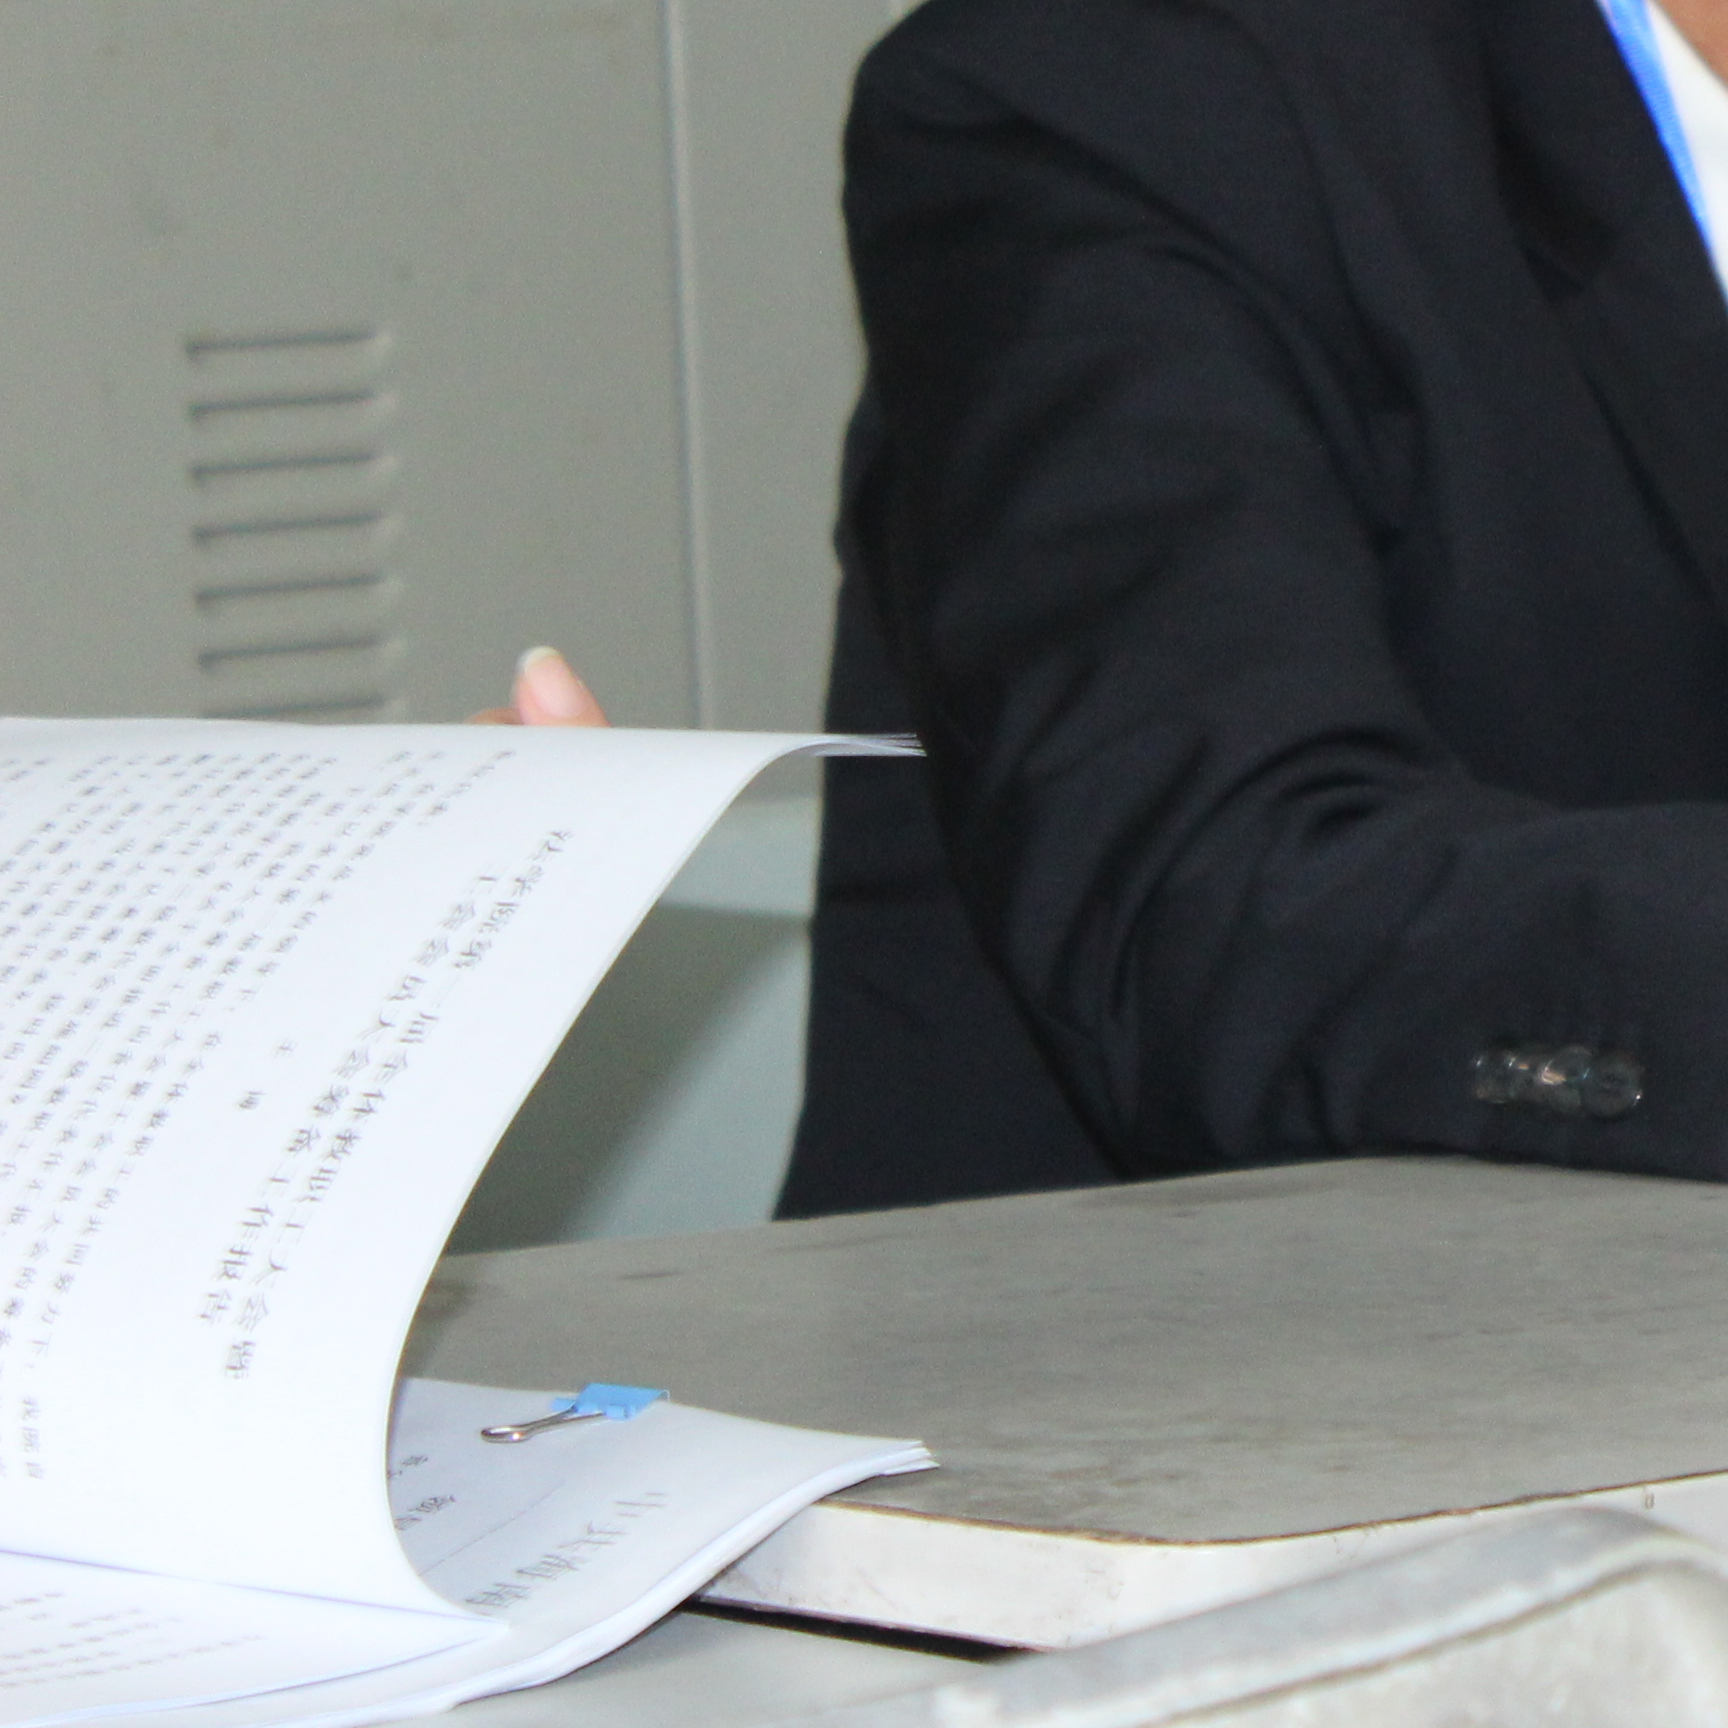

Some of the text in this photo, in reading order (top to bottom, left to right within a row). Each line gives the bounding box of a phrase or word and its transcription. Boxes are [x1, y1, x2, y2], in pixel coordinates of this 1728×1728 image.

[195, 859, 509, 1329] 工会会员大会筹备工作报告
[464, 1490, 668, 1616] 中共海南
